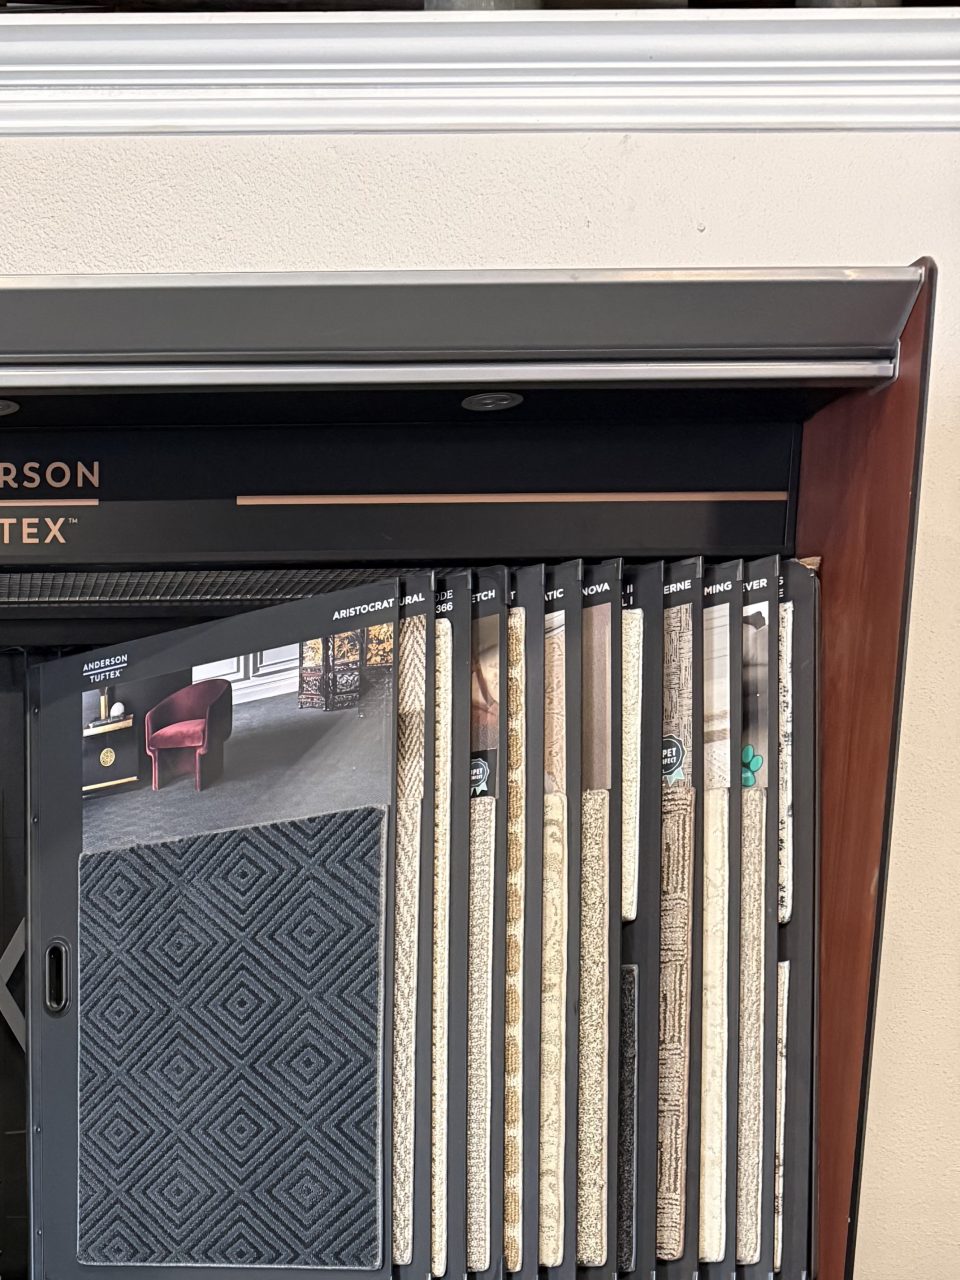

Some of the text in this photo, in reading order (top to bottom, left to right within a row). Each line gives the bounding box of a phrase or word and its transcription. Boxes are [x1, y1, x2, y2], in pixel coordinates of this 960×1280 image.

[703, 581, 733, 596] MING
[332, 598, 395, 621] ARISTOCRAT
[82, 653, 128, 672] ANDERSON
